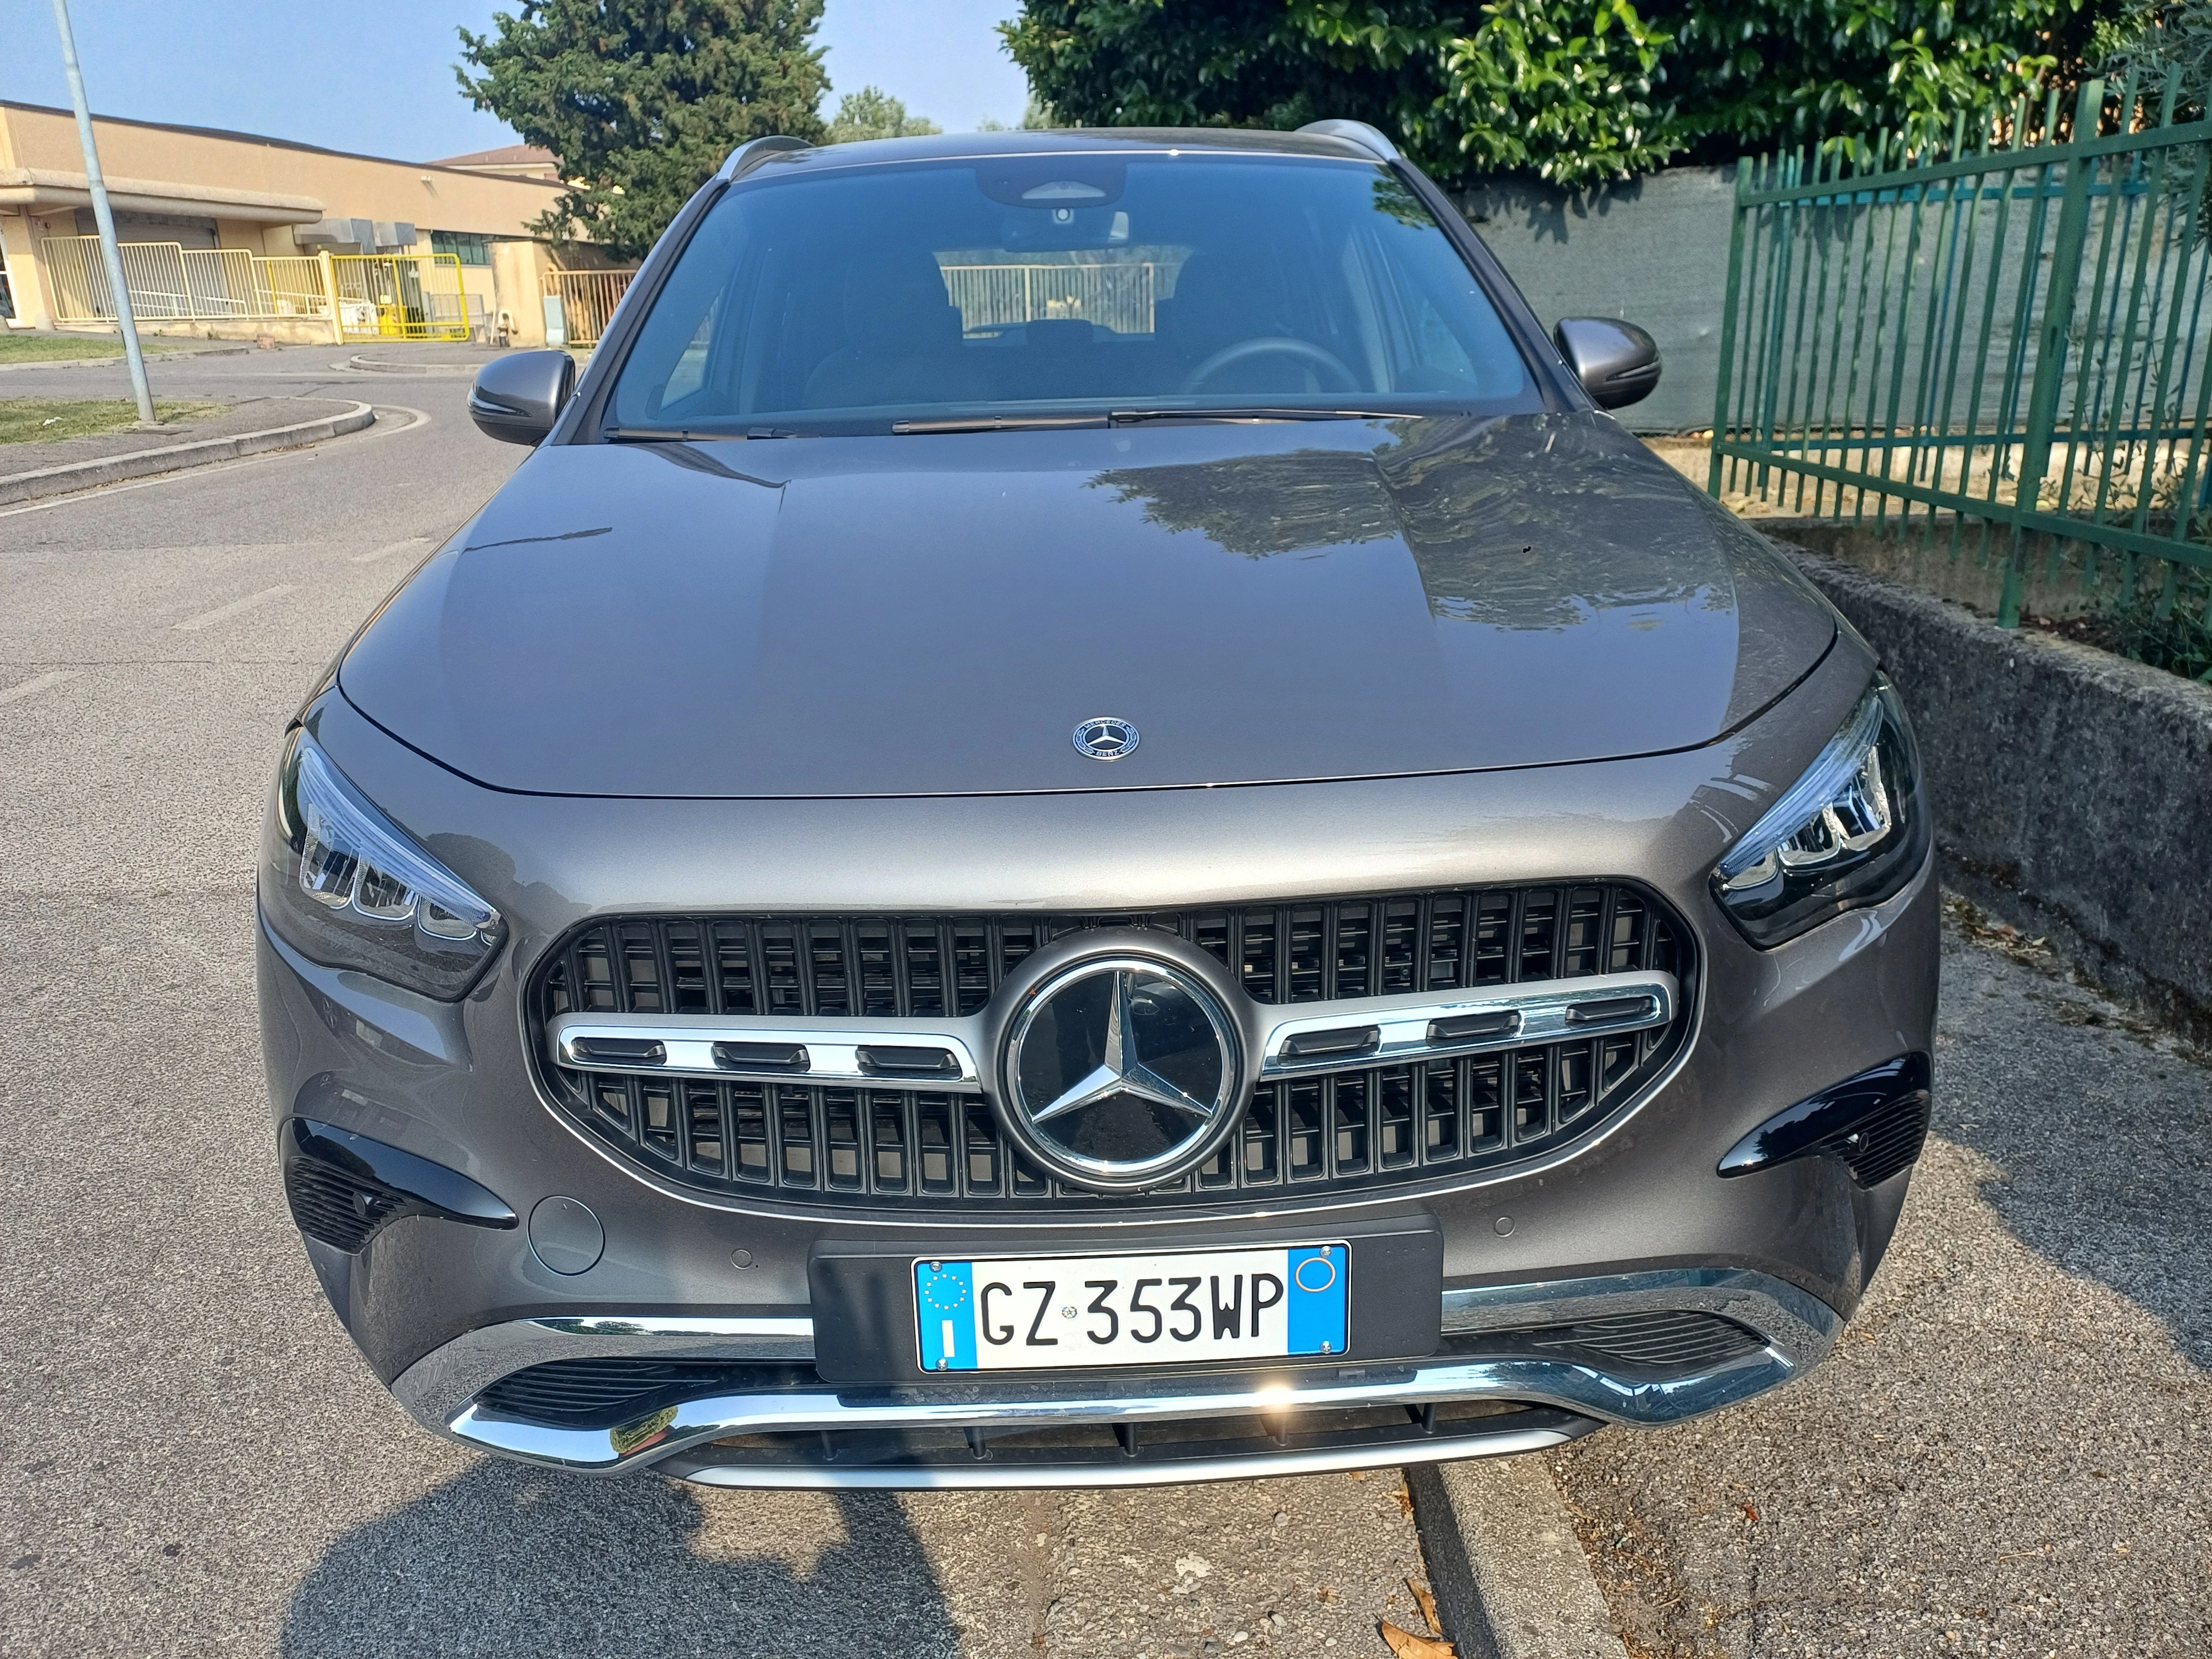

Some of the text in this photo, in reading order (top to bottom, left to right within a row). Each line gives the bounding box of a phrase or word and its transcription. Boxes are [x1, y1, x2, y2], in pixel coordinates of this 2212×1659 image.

[1085, 720, 1126, 729] MERCEDES
[980, 1274, 1284, 1347] GZ 353WP
